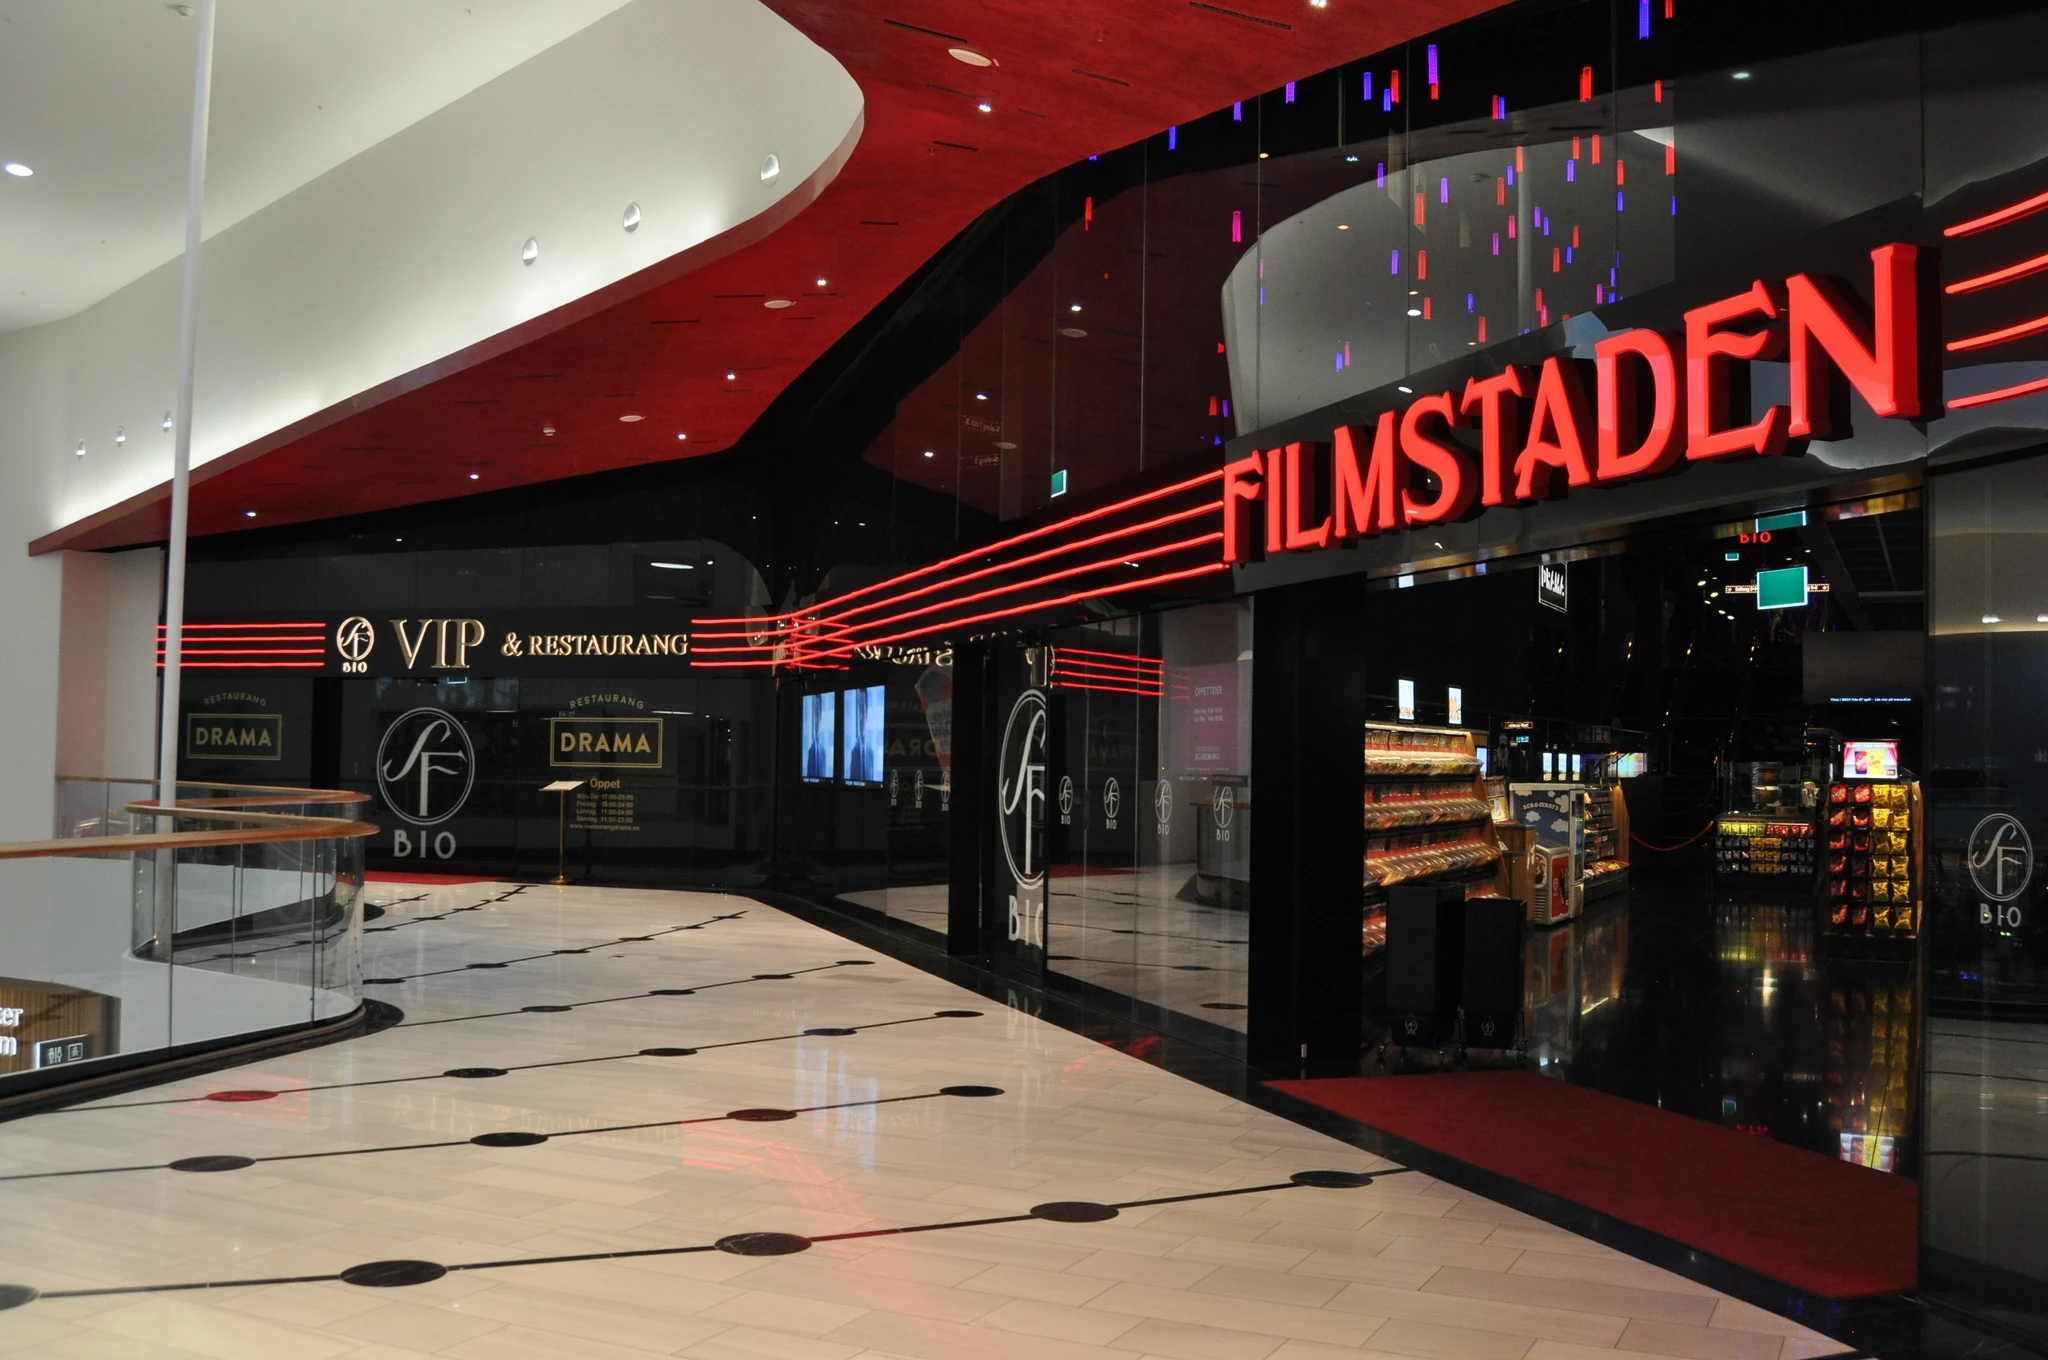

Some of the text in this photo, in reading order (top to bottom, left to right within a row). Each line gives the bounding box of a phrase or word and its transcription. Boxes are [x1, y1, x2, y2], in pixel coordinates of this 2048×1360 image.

[1222, 242, 1940, 562] FILMSTADEN
[1739, 531, 1772, 544] BIO
[390, 618, 688, 669] VIP & RESTAURANG
[342, 661, 368, 673] BIO
[203, 692, 267, 707] RESTAURANG
[569, 694, 644, 710] RESTAURANG
[195, 726, 272, 747] DRAMA
[560, 732, 652, 753] DRAMA
[590, 777, 621, 790] Öppet
[1106, 819, 1117, 830] BIO
[1157, 824, 1170, 836] BIO
[1216, 829, 1230, 842] BIO
[393, 829, 457, 859] BIO
[1979, 902, 2022, 929] BIO
